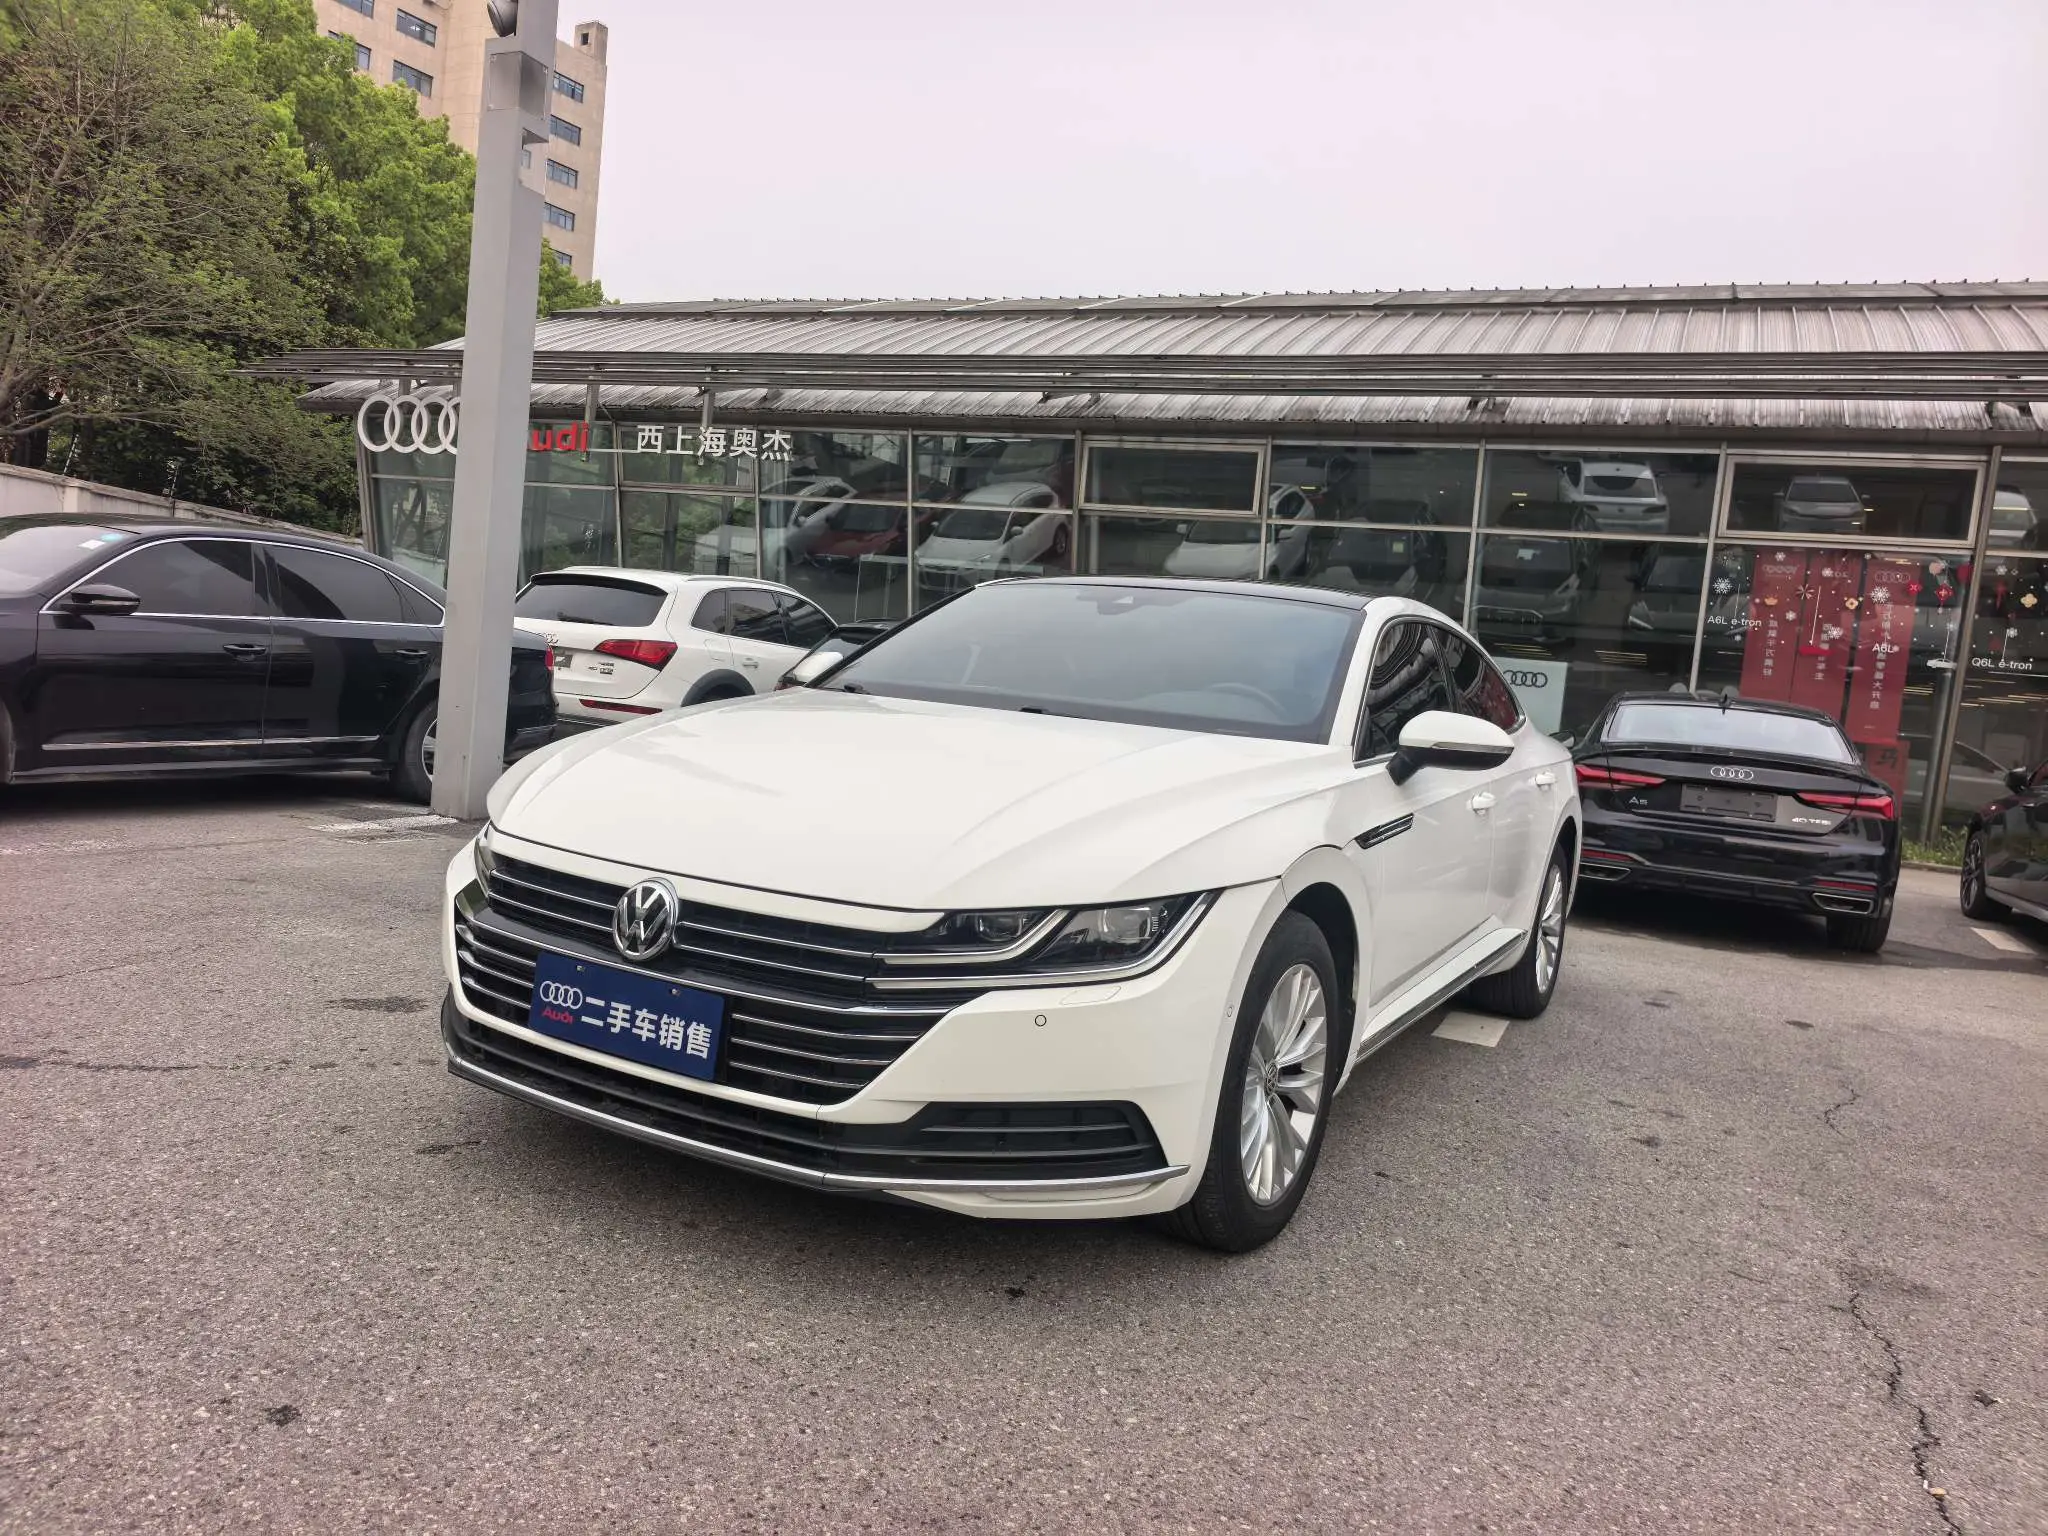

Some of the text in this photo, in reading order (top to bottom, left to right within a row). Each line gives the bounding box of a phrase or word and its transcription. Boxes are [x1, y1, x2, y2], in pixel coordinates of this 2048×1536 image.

[531, 421, 589, 452] udi
[637, 424, 793, 461] 西上海奥杰
[1707, 615, 1763, 627] A6L e-tron
[1872, 642, 1894, 653] A6L
[1971, 657, 2033, 670] Q6L e-tron
[613, 879, 676, 960] VW
[541, 1006, 575, 1025] Audi
[581, 996, 713, 1060] 二手车销售
